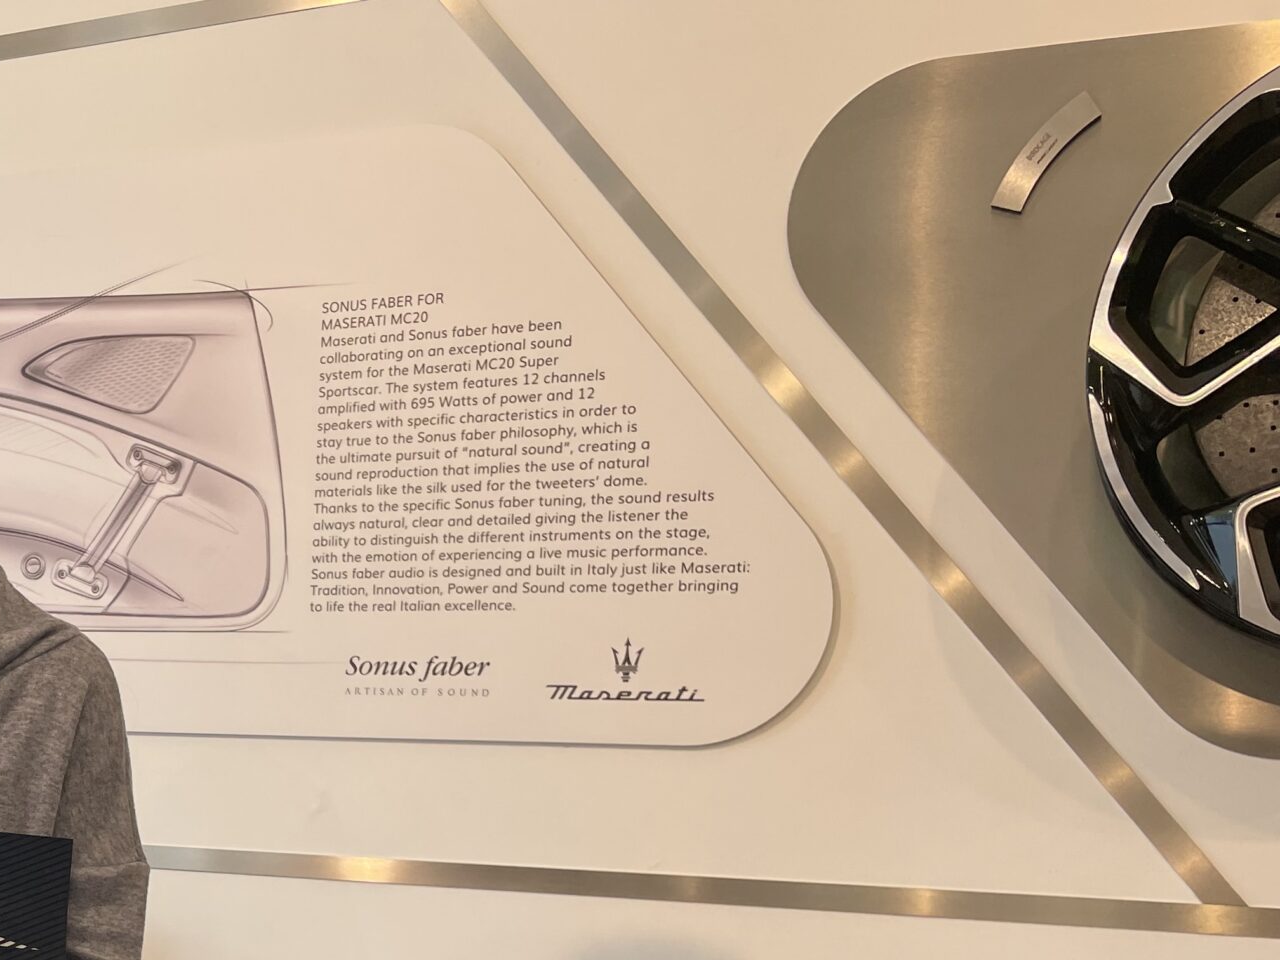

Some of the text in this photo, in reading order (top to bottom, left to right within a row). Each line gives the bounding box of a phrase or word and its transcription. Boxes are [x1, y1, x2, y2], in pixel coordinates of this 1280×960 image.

[322, 292, 444, 314] SONUS FABER FOR
[321, 310, 429, 331] MASERATI MC20
[320, 320, 562, 348] Maserati and Sonus faber have been
[320, 334, 572, 365] collaborating on an exceptional sound
[319, 356, 559, 384] system for the Maserati MC20 Super
[318, 368, 606, 401] Sportscar. The system features 12 channels
[318, 386, 595, 416] amplified with 695 Watts of power and 12
[317, 404, 637, 434] speakers with specific characteristics in order to
[316, 420, 638, 450] stay true to the Sonus faber philosophy, which is
[316, 453, 336, 465] the
[339, 452, 392, 464] ultimate
[395, 448, 440, 464] pursuit
[444, 446, 458, 459] of
[578, 439, 636, 454] creating
[640, 440, 650, 450] a
[315, 455, 650, 482] sound reproduction that implies the use of natural
[314, 484, 372, 498] materials
[376, 484, 398, 496] like
[402, 483, 423, 495] the
[426, 481, 447, 494] silk
[451, 480, 482, 493] used
[486, 479, 506, 492] for
[509, 478, 532, 491] the
[603, 474, 647, 488] dome.
[313, 489, 715, 514] Thanks to the specific Sonus faber tuning, the sound results
[313, 508, 688, 533] always natural, clear and detailed giving the listener the
[312, 527, 710, 549] ability to distinguish the different instruments on the stage,
[312, 544, 708, 564] with the emotion of experiencing a live music performance.
[311, 560, 750, 580] Sonus faber audio is designed and built in Italy just like Maserati:
[310, 579, 739, 597] Tradition, Innovation, Power and Sound come together bringing
[310, 599, 516, 612] to life the real Italian excellence.
[344, 655, 491, 683] Sonus faber
[344, 686, 491, 698] ARTISAN OF SOUND
[545, 684, 706, 703] Maserati
